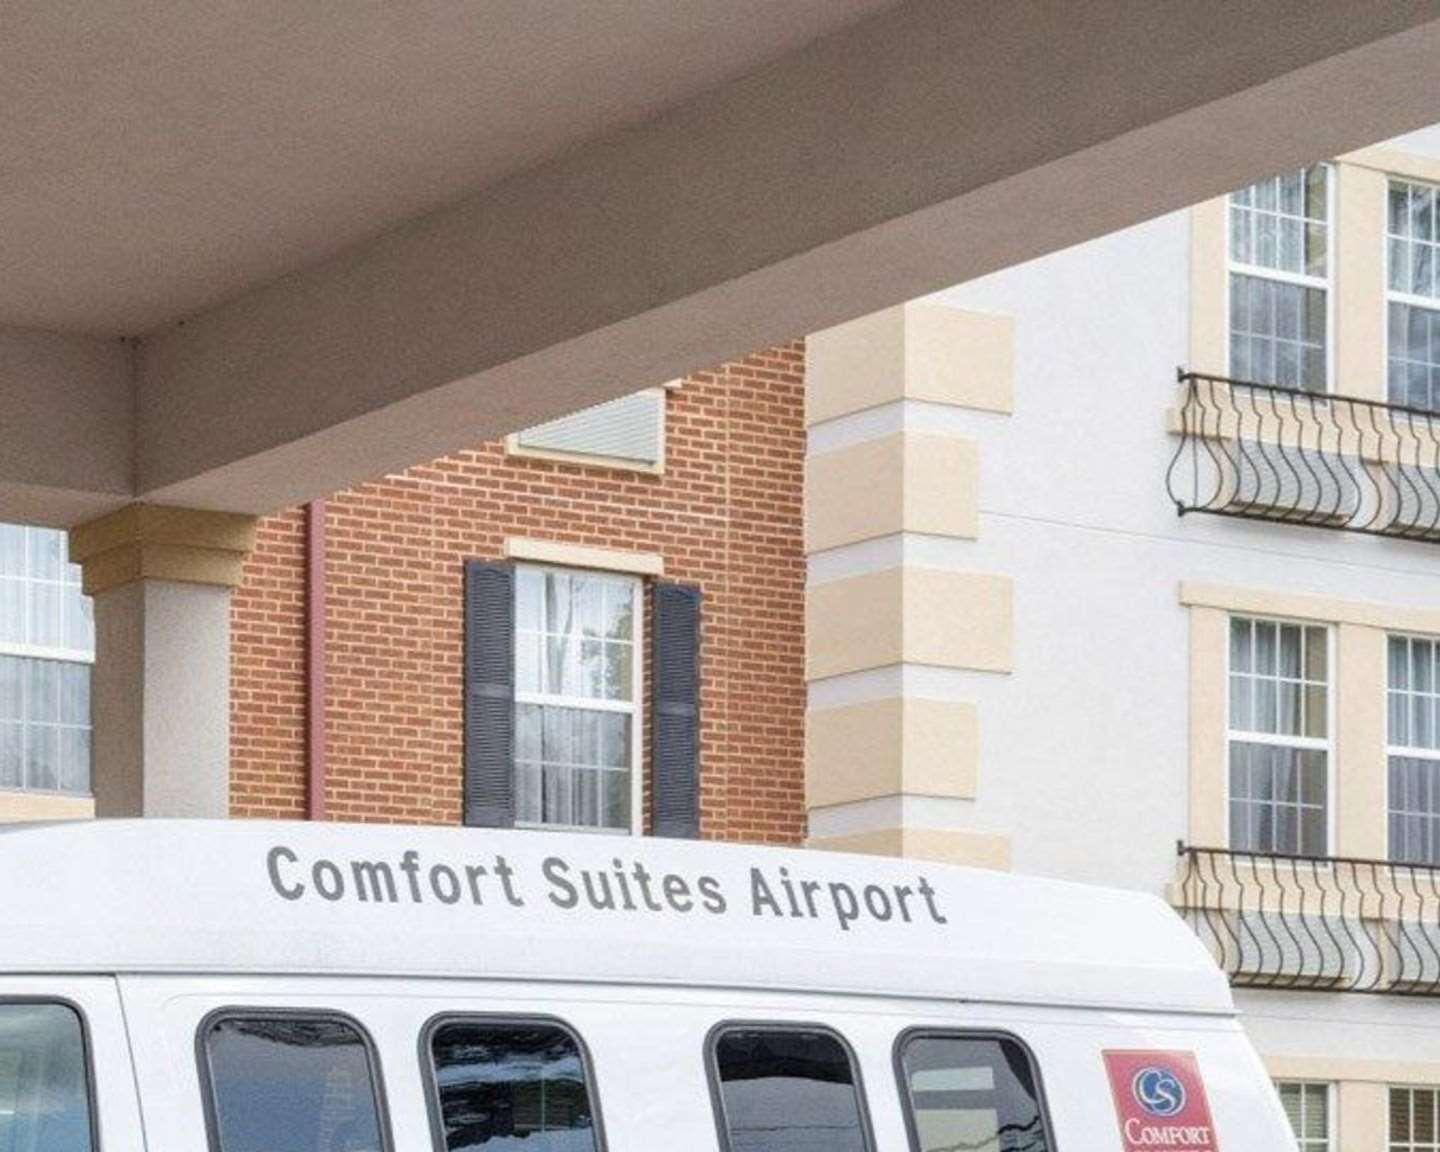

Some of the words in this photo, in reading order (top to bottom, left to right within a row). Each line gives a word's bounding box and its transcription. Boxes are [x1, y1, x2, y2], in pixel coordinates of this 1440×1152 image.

[266, 845, 524, 908] Comfort
[540, 857, 727, 914] Suites
[751, 867, 947, 930] Airport
